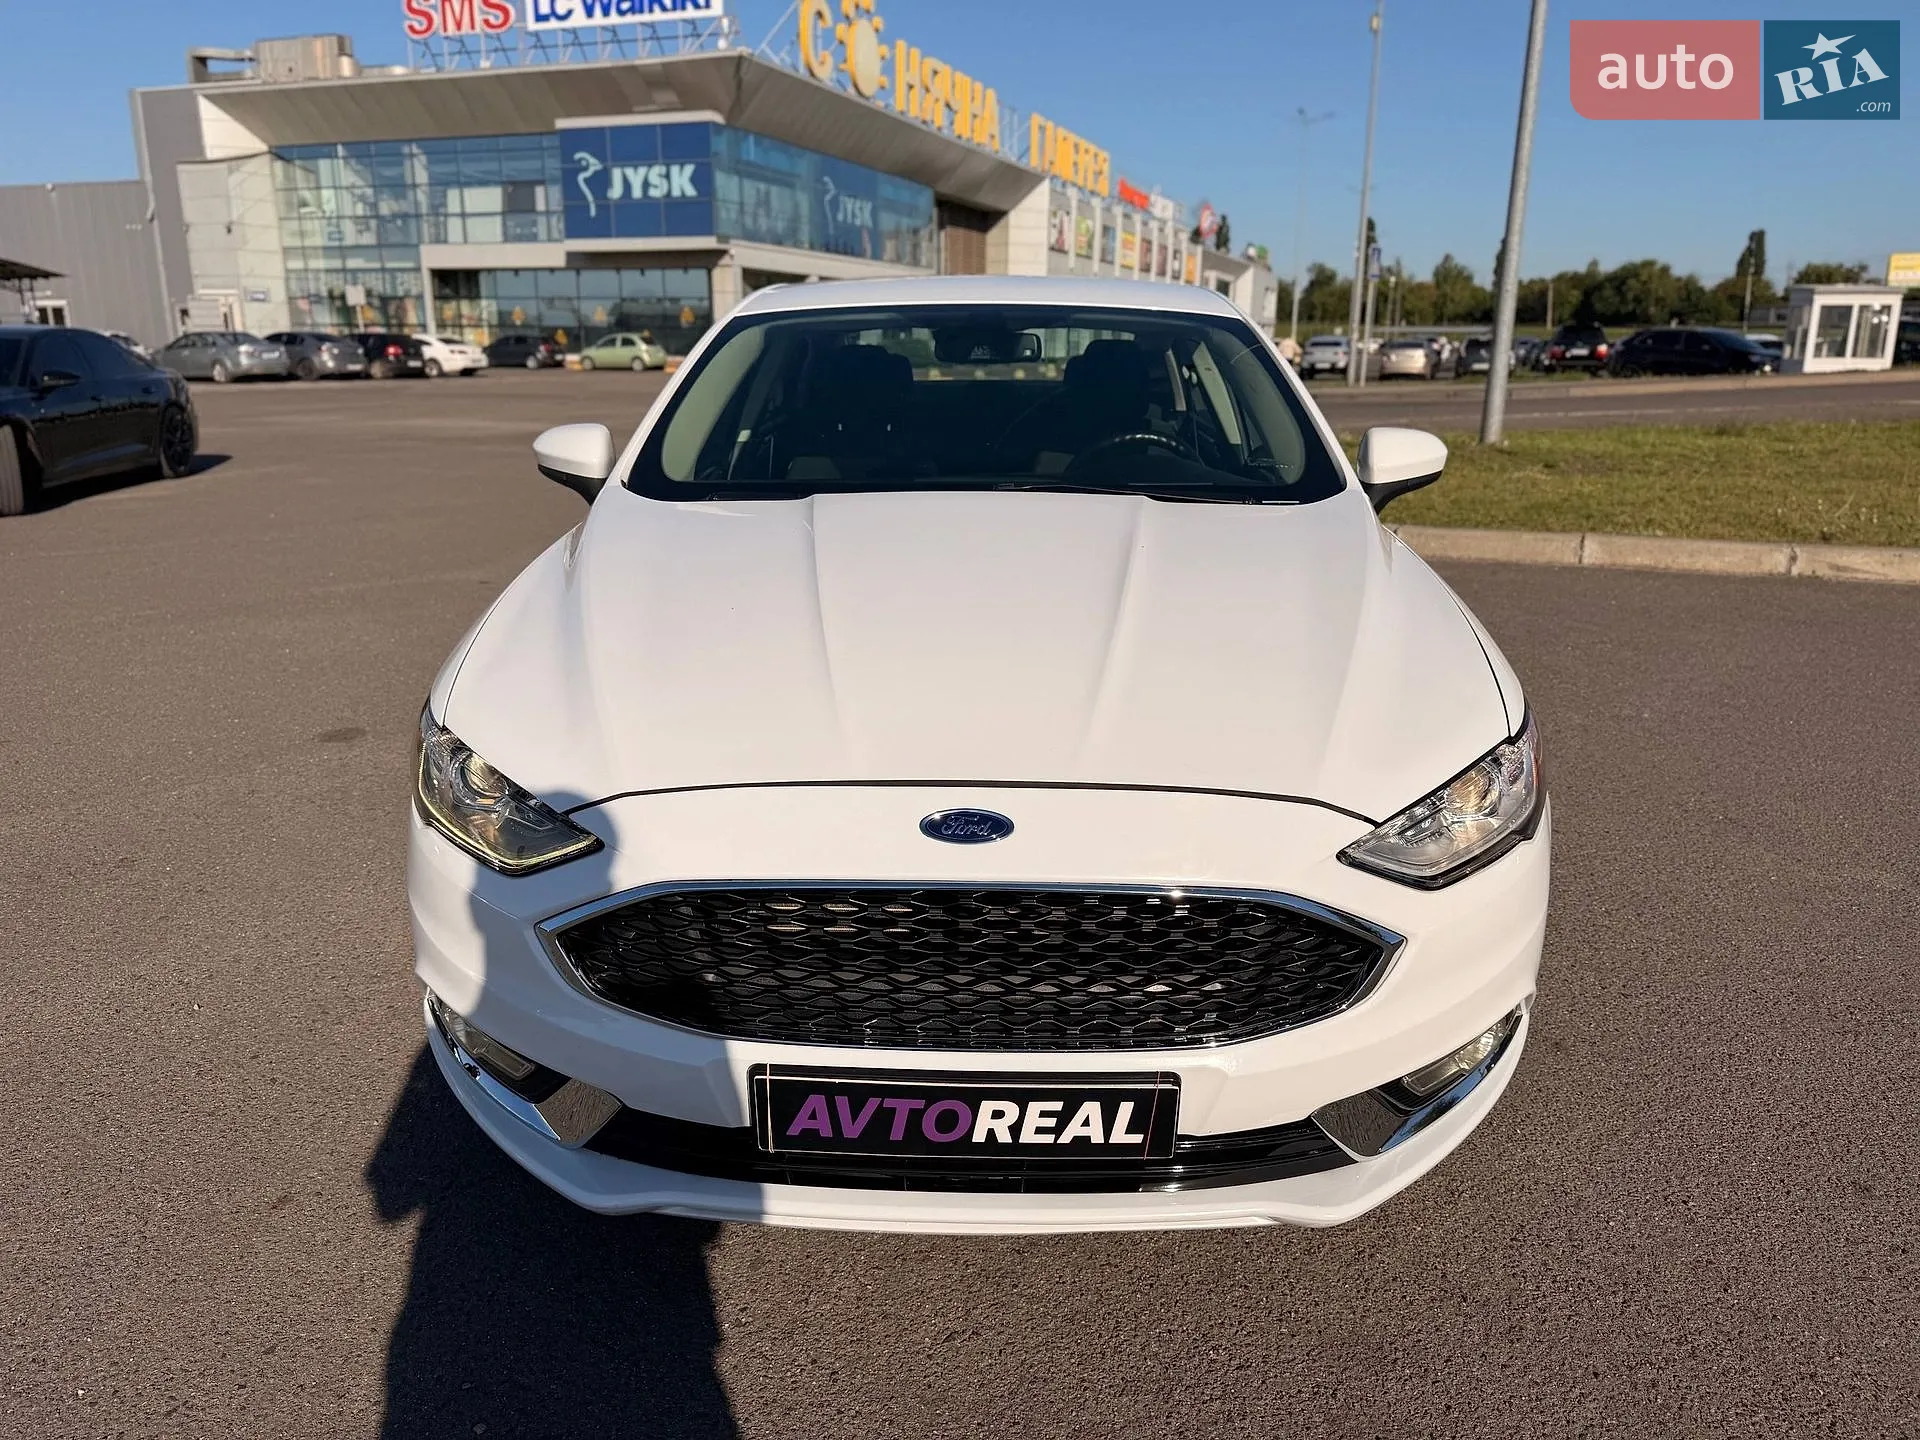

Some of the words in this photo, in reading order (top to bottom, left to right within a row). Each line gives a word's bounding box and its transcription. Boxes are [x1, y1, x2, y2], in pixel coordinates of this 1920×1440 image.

[404, 0, 512, 37] SMS
[607, 164, 698, 200] JYSK
[836, 195, 874, 228] JYSK
[941, 815, 992, 836] Ford
[786, 1094, 1145, 1145] AVTOREAL
